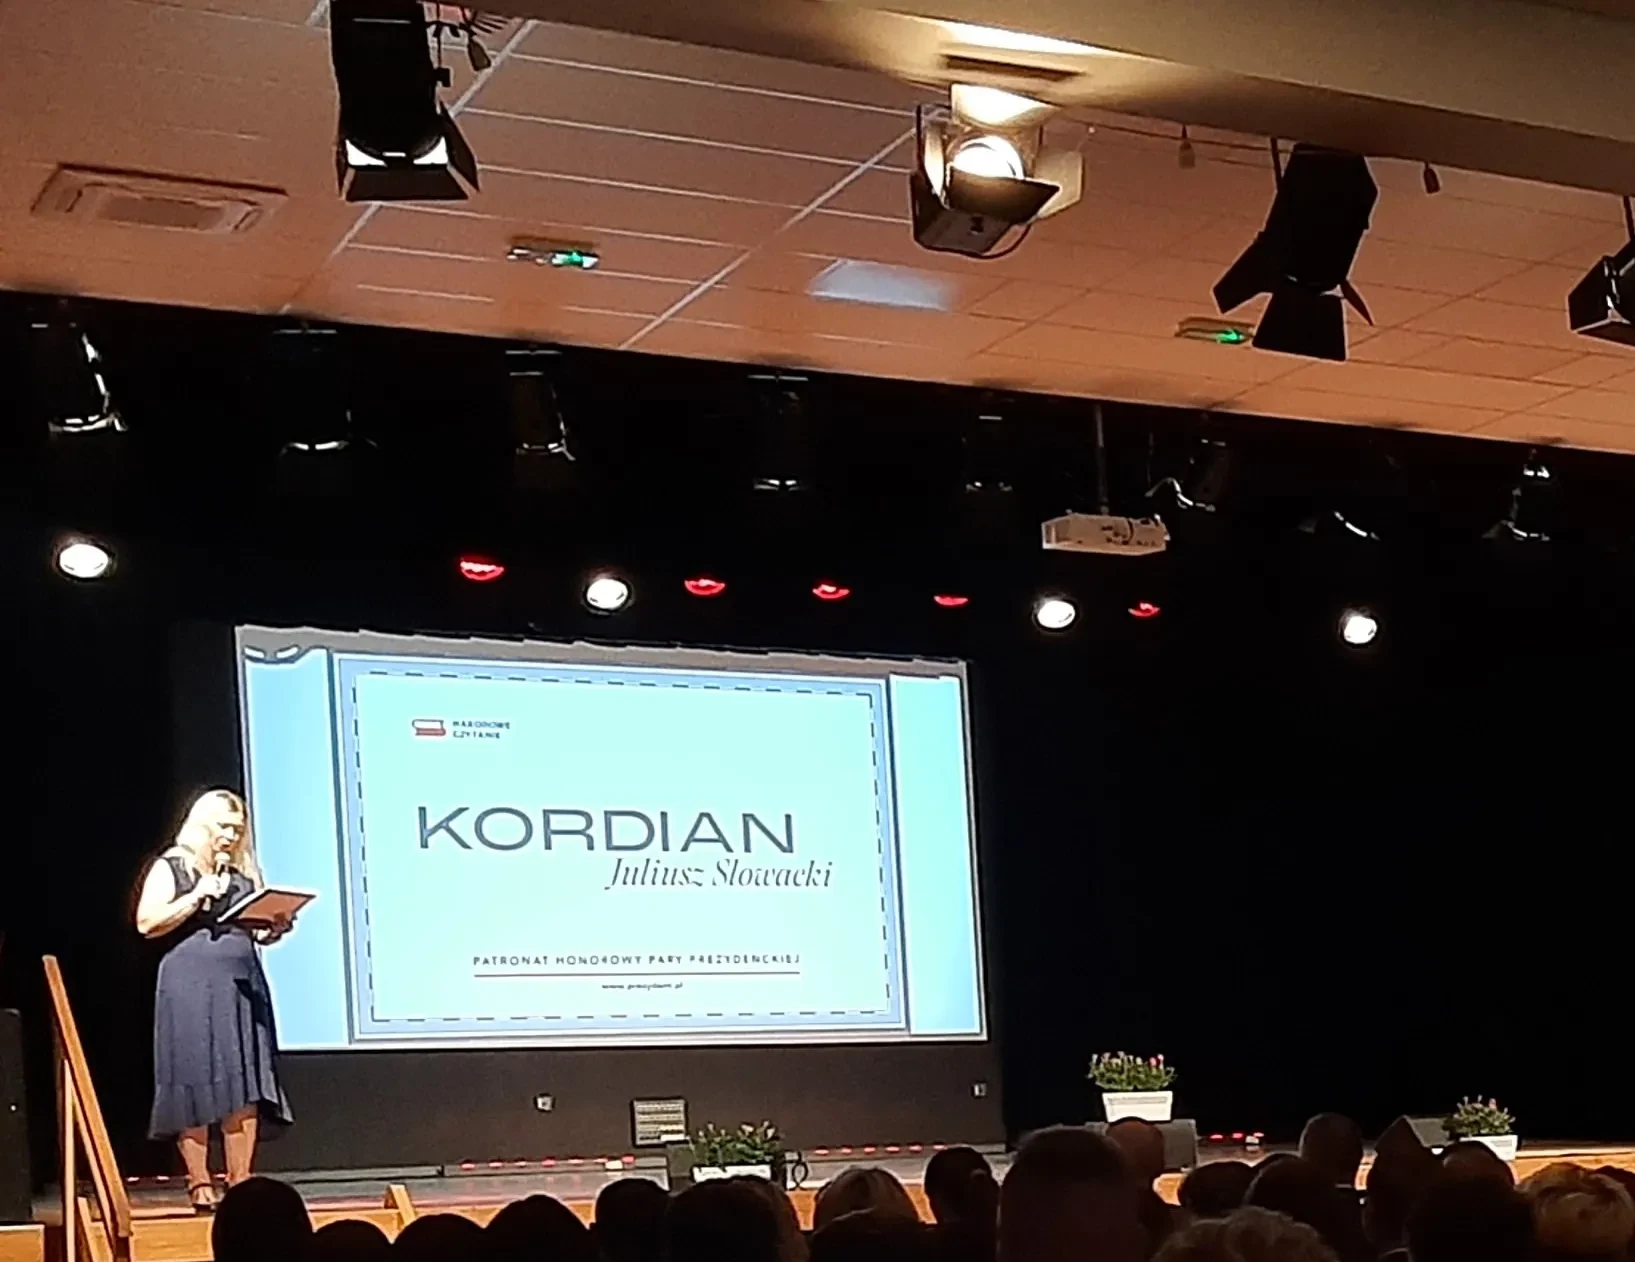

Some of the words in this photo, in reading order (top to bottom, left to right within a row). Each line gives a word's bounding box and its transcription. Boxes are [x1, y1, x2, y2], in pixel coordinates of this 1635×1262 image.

[418, 806, 794, 853] KORDIAN
[604, 858, 704, 890] Juliusz
[473, 955, 548, 966] PATRONAT
